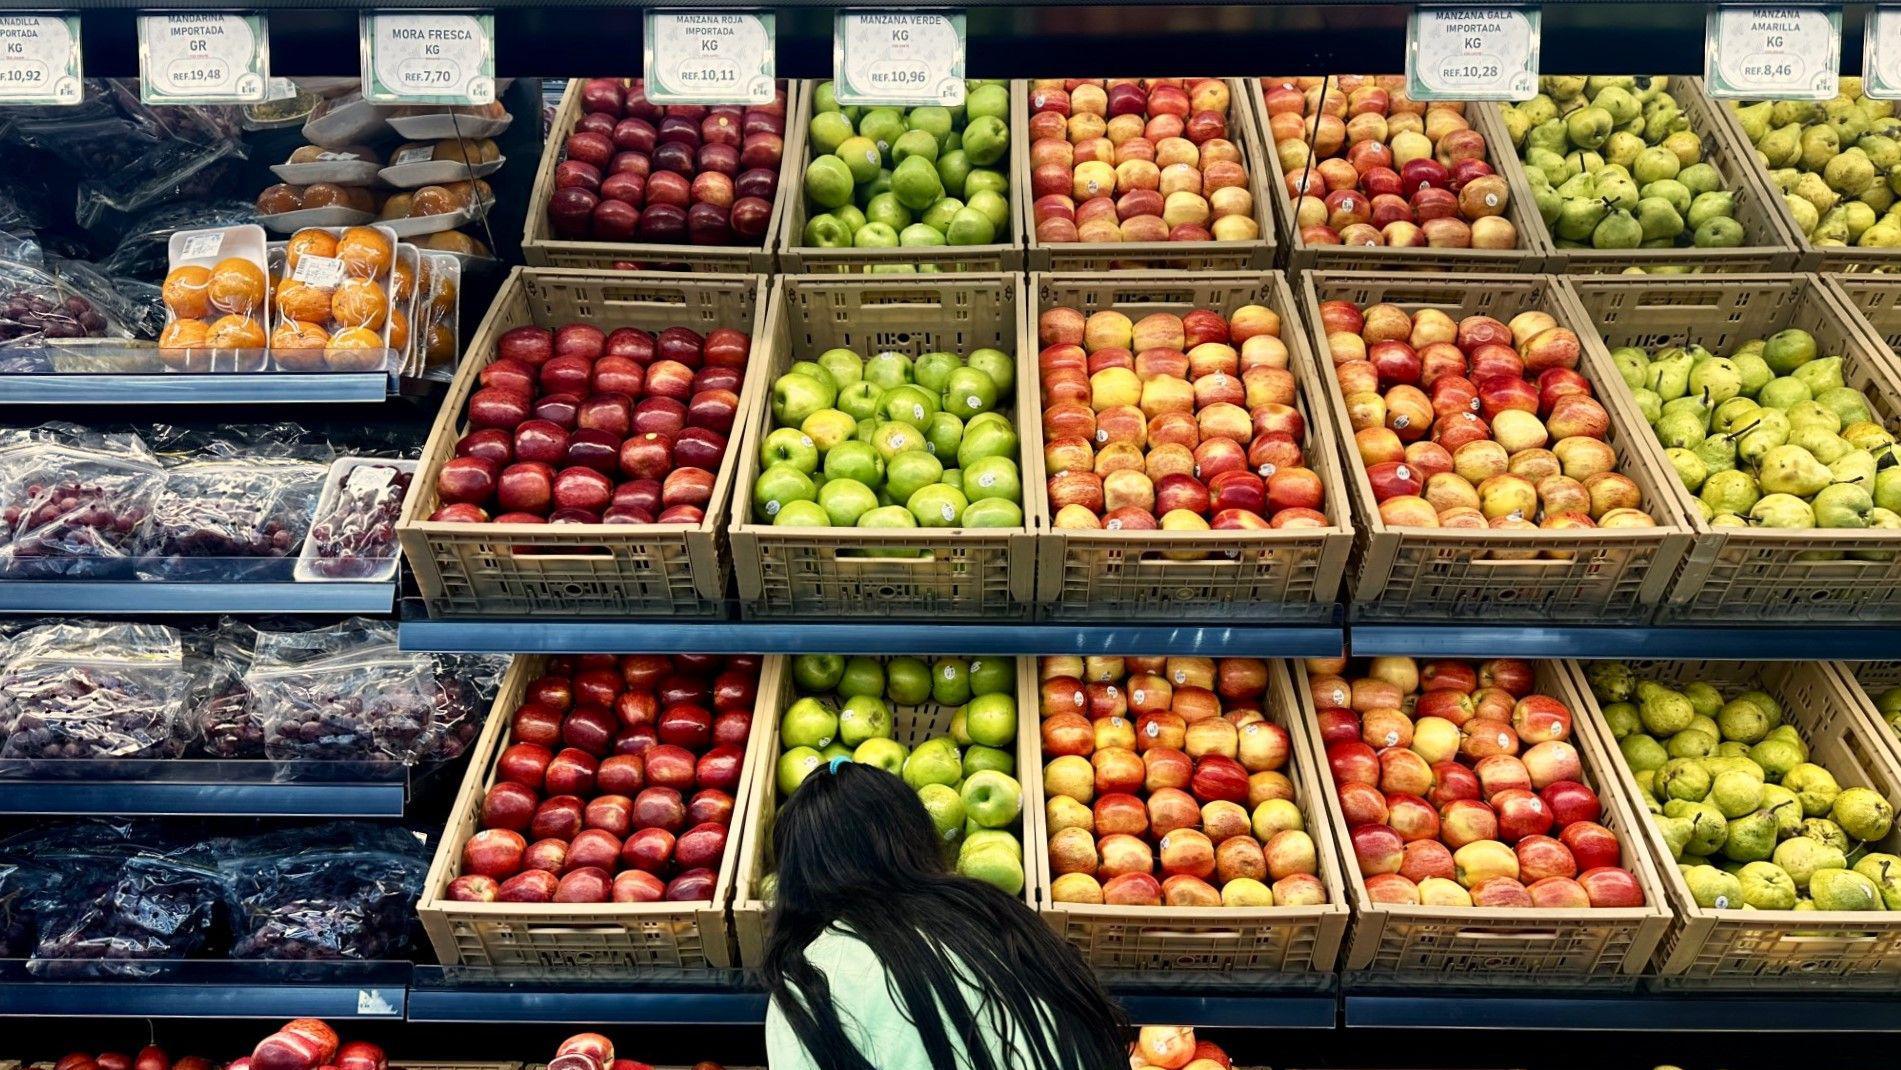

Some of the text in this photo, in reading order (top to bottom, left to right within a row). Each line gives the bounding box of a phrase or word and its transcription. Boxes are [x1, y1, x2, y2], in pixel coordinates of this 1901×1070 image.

[676, 15, 743, 24] MANZANA ROJA
[860, 15, 941, 25] MANZANA VERDE
[1436, 10, 1513, 20] MANZANA GALA
[1753, 10, 1800, 19] MANZANA
[170, 26, 224, 36] IMPORTADA
[685, 27, 734, 36] IMPORTADA
[1446, 24, 1501, 33] IMPORTADA
[1751, 22, 1800, 31] AMARILLA
[392, 29, 472, 40] MORA FRESCA
[892, 30, 909, 41] KG
[190, 40, 207, 51] GR
[702, 40, 718, 51] KG
[1464, 37, 1481, 49] KG
[1766, 36, 1783, 47] KG
[8, 43, 23, 53] KG
[425, 44, 440, 55] KG
[681, 70, 735, 82] REF.10,11
[1443, 66, 1498, 78] REF.10,28
[1745, 64, 1792, 77] REF.8,46
[405, 71, 451, 83] REF.7,70
[872, 71, 926, 84] REF.10,96
